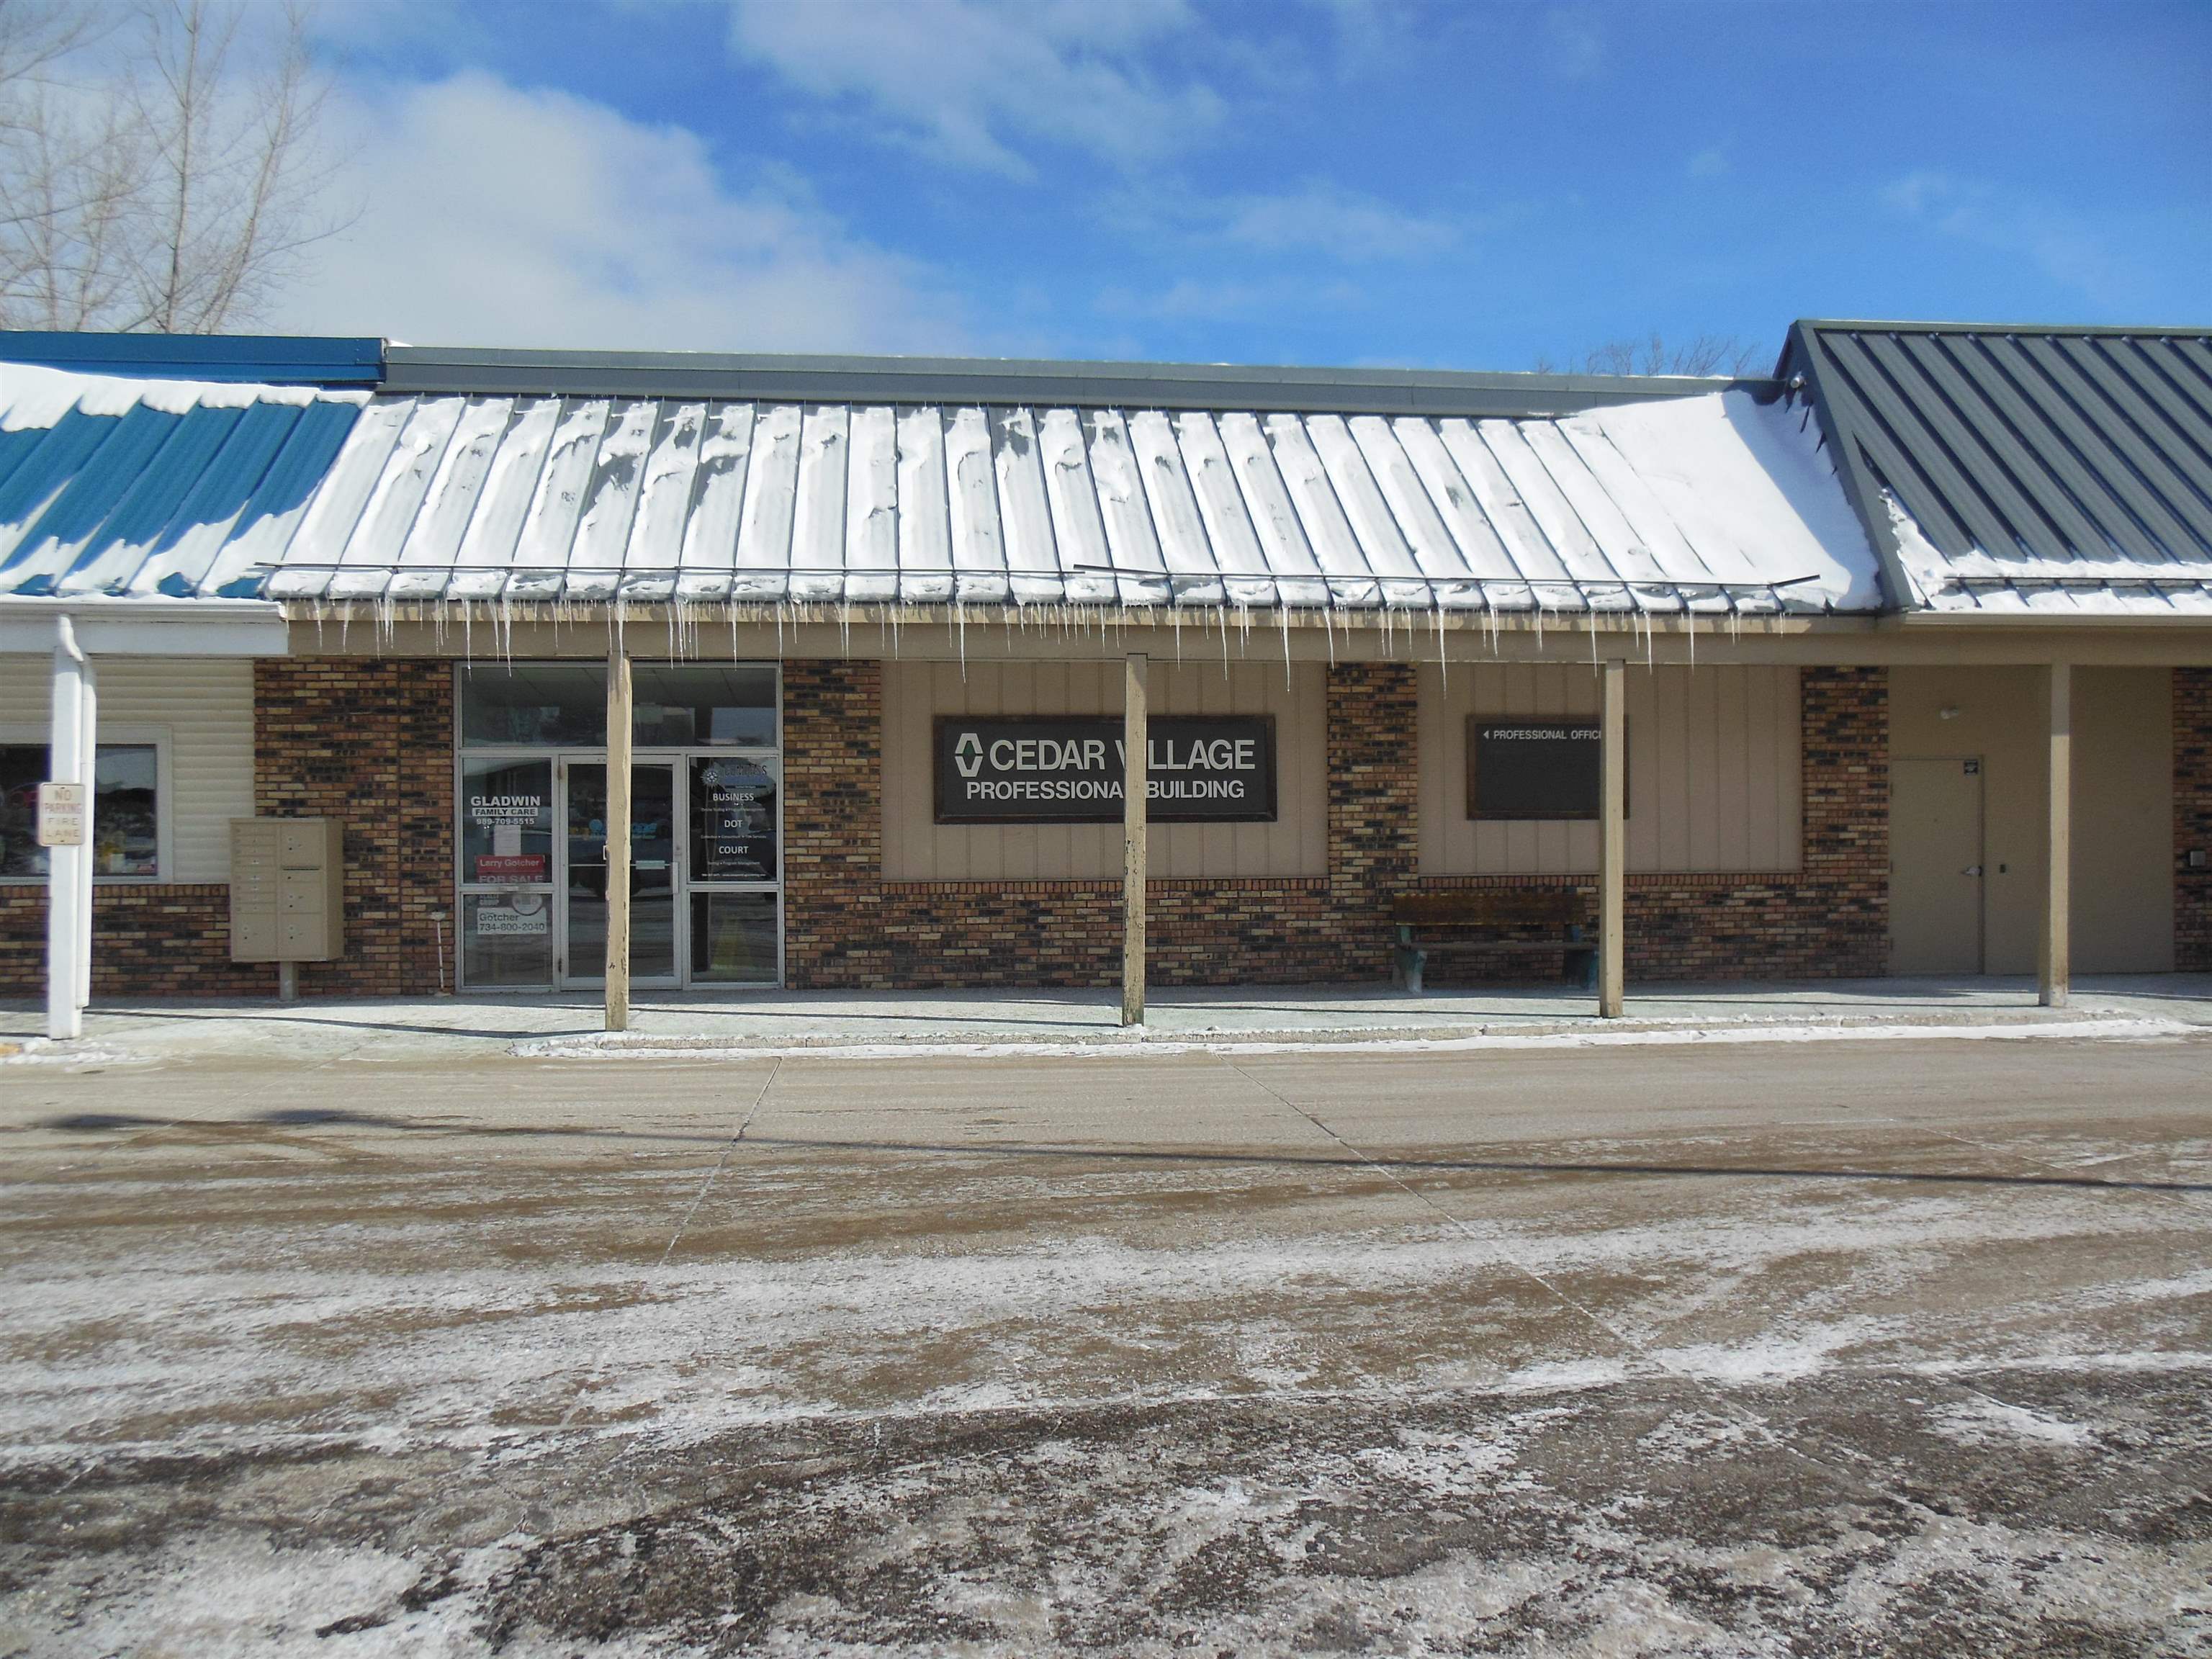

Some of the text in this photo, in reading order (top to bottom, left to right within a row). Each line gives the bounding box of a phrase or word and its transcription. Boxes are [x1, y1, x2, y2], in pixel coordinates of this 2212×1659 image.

[1493, 730, 1601, 739] PROFESSIONAL OFFIC
[989, 739, 1256, 771] CEDAR LLAGE
[55, 789, 72, 801] NO
[966, 780, 1244, 800] PROFESSIONA BUILDING
[470, 796, 541, 806] GLADWIN
[713, 793, 755, 801] BUSINESS
[45, 803, 81, 814] PARKING
[48, 817, 78, 826] FIRE
[724, 819, 743, 828] DOT
[46, 829, 80, 837] LANE
[480, 859, 502, 868] Larry
[479, 912, 520, 922] Gotcher
[479, 922, 545, 932] 734-800-2040
